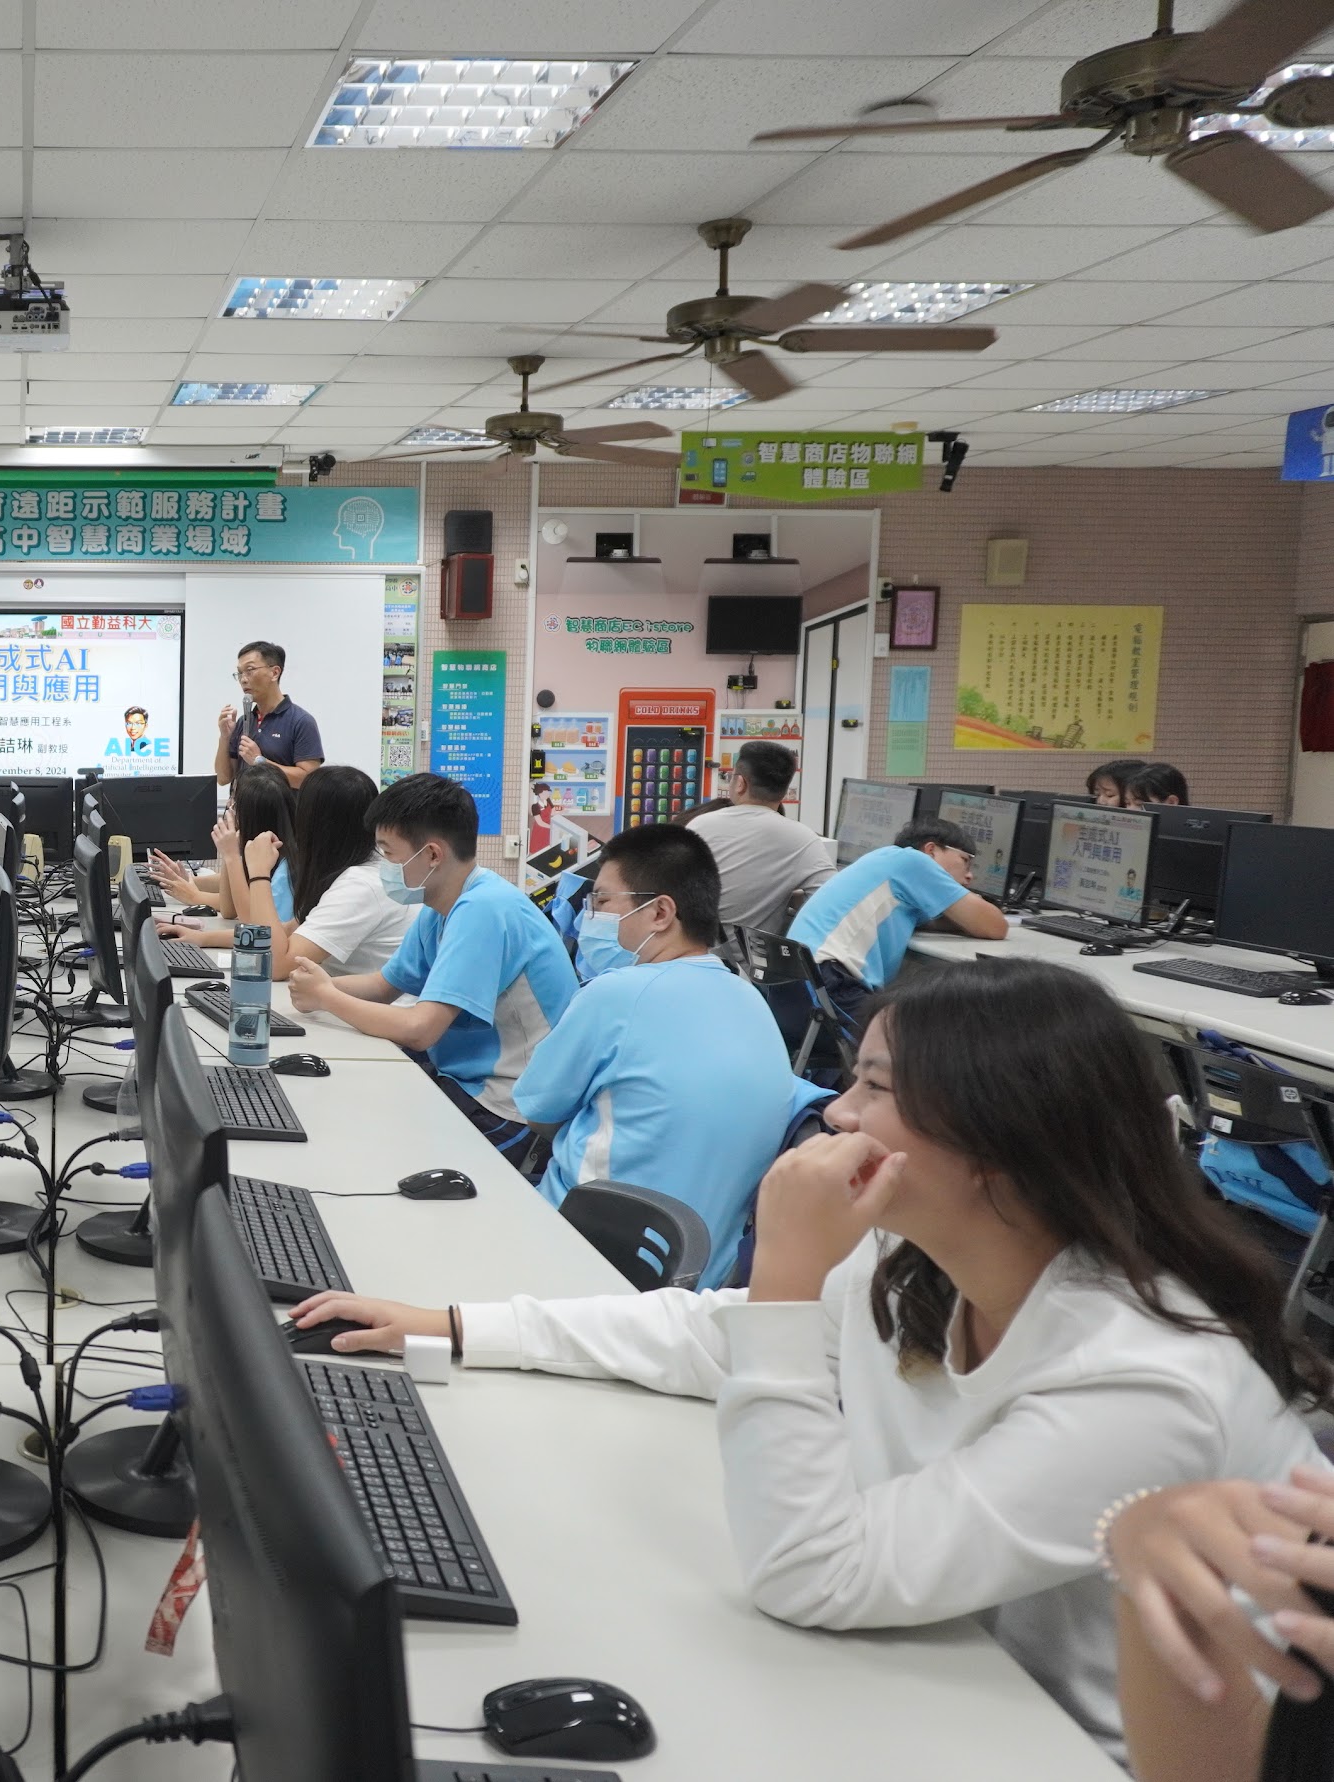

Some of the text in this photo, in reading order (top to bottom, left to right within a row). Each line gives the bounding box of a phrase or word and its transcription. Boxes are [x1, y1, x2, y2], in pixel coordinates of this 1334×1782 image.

[757, 440, 917, 465] 智慧商店物聯網
[802, 466, 871, 489] 體驗區
[60, 615, 153, 631] 國立勤益科大
[585, 637, 672, 654] 物聯網體驗區
[634, 705, 700, 715] COLD DRINKS
[37, 743, 69, 754] 副教授
[103, 737, 171, 757] AICE
[111, 756, 152, 764] Department
[35, 766, 43, 776] 8,
[45, 766, 67, 775] 2024
